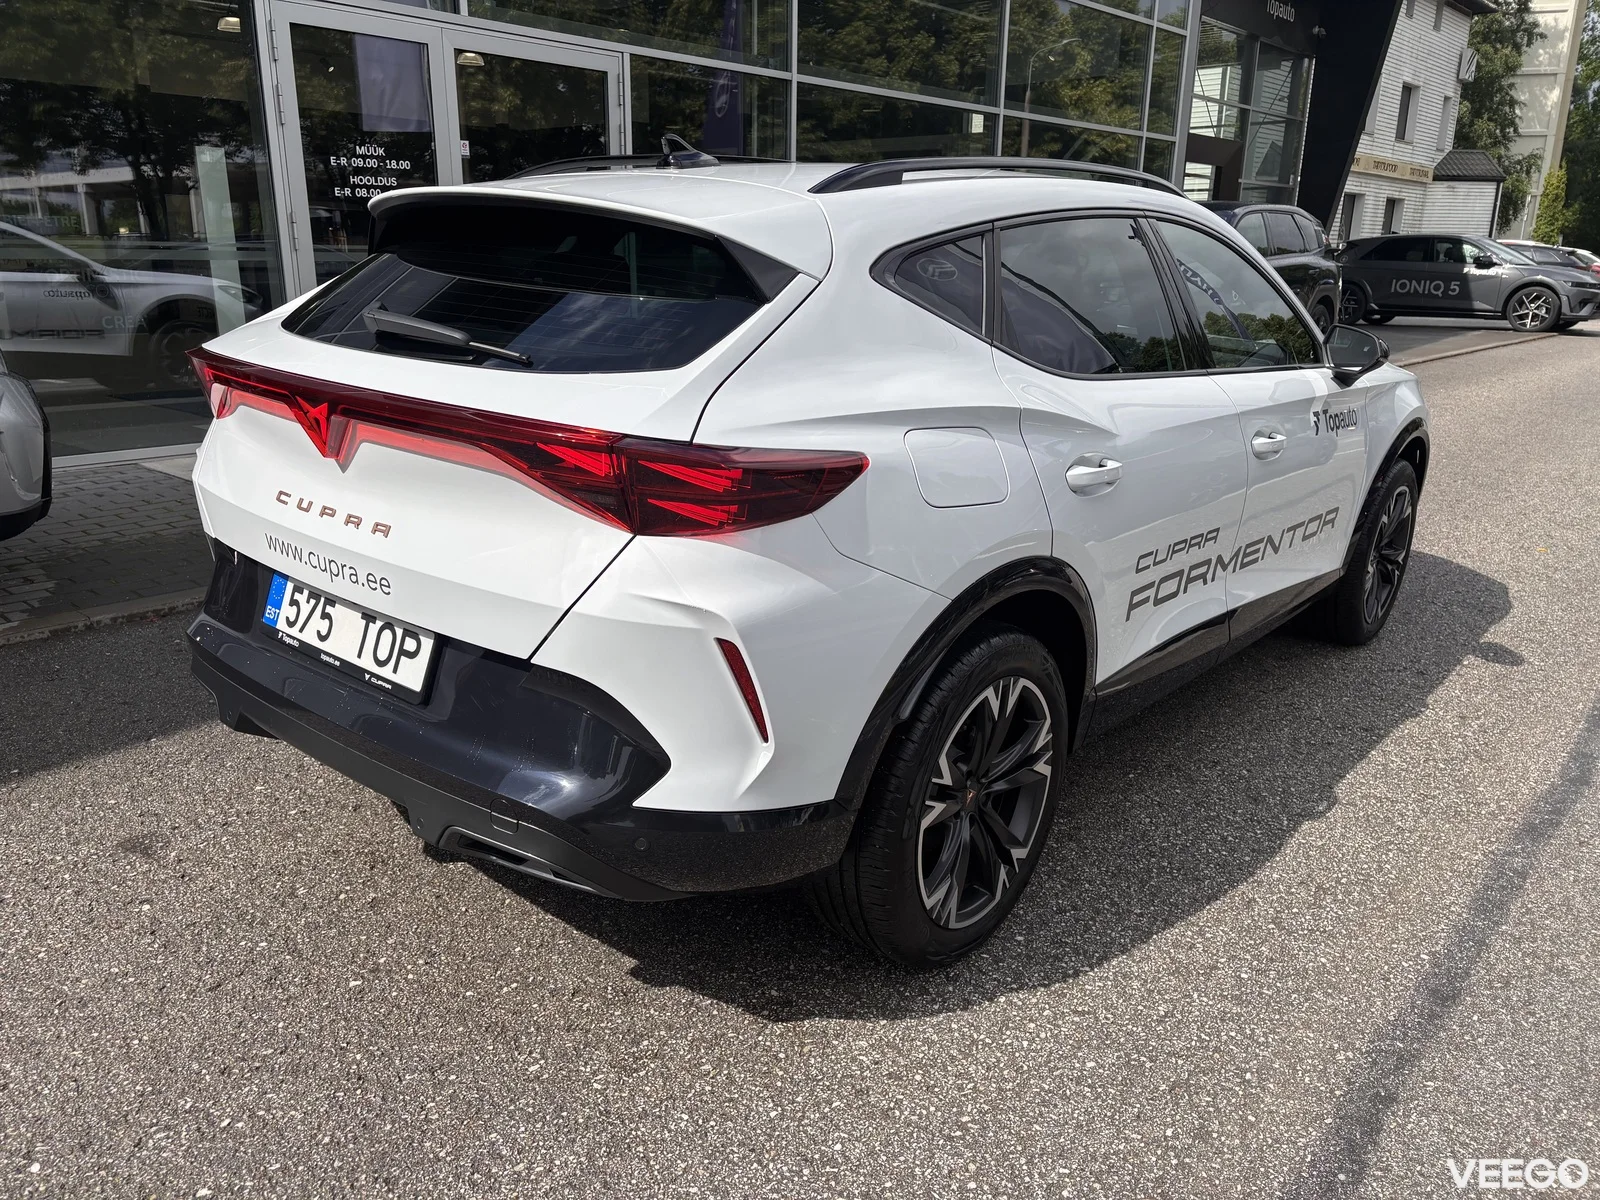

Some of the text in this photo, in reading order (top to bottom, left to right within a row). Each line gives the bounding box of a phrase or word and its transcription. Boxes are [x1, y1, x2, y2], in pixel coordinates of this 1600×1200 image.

[1267, 0, 1295, 22] Topauto
[356, 144, 386, 156] MÜÜK
[330, 156, 348, 166] E-R
[351, 158, 378, 168] 09.00
[385, 160, 411, 170] 18.00
[350, 175, 397, 186] HOOLDUS
[334, 187, 352, 197] E-R
[1391, 279, 1460, 297] IONIQ 5
[1322, 406, 1358, 437] Topauto
[275, 490, 391, 538] CUPRA
[1135, 527, 1221, 574] CUPRA
[264, 533, 391, 596] www.cupra.ee
[1125, 506, 1340, 622] FORMENTOR
[265, 605, 280, 621] EST
[285, 583, 422, 675] 575 TOP
[282, 632, 300, 648] Topauto
[370, 677, 392, 690] CUPRA
